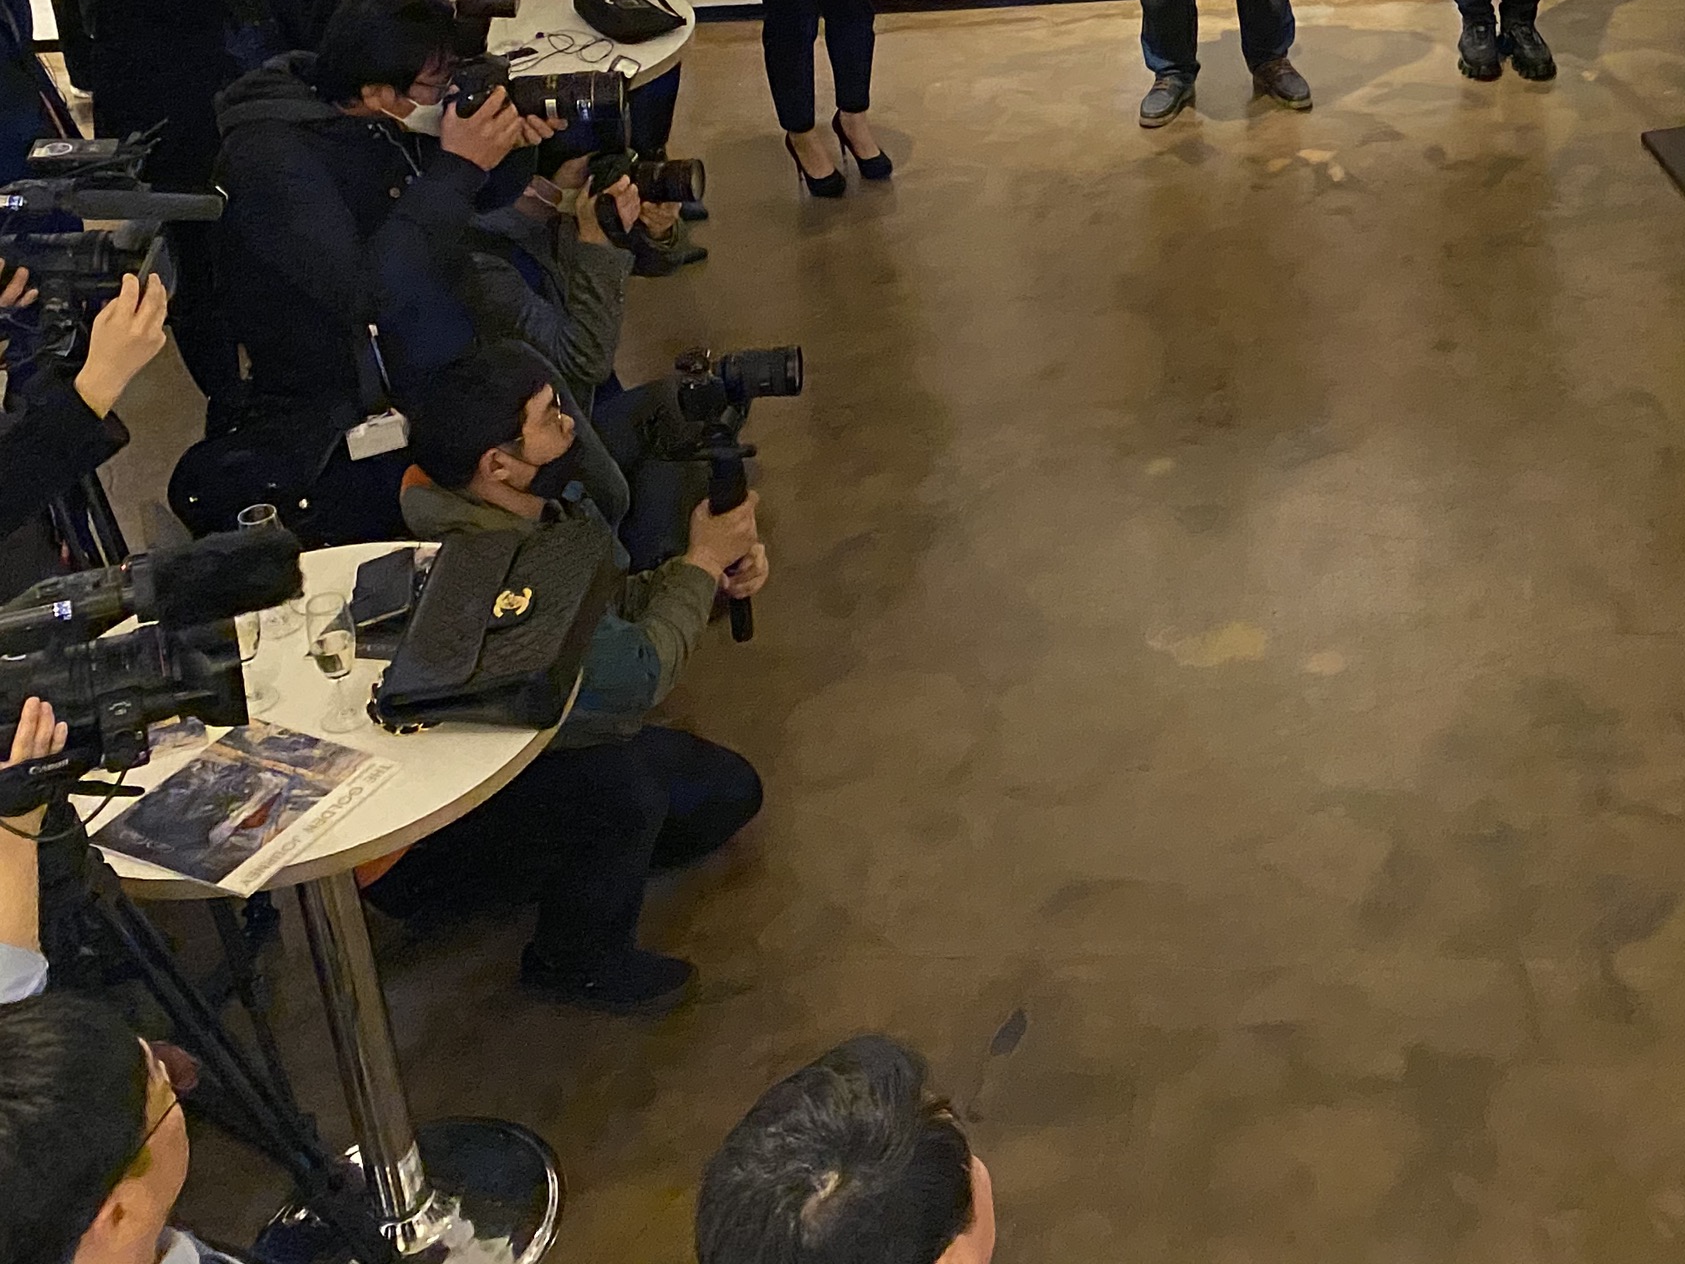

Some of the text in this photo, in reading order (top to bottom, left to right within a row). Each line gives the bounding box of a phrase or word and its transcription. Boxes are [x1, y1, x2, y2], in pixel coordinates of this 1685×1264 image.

[362, 763, 394, 784] THE
[302, 786, 363, 833] GOLDEN
[240, 835, 301, 887] JOURNEY
